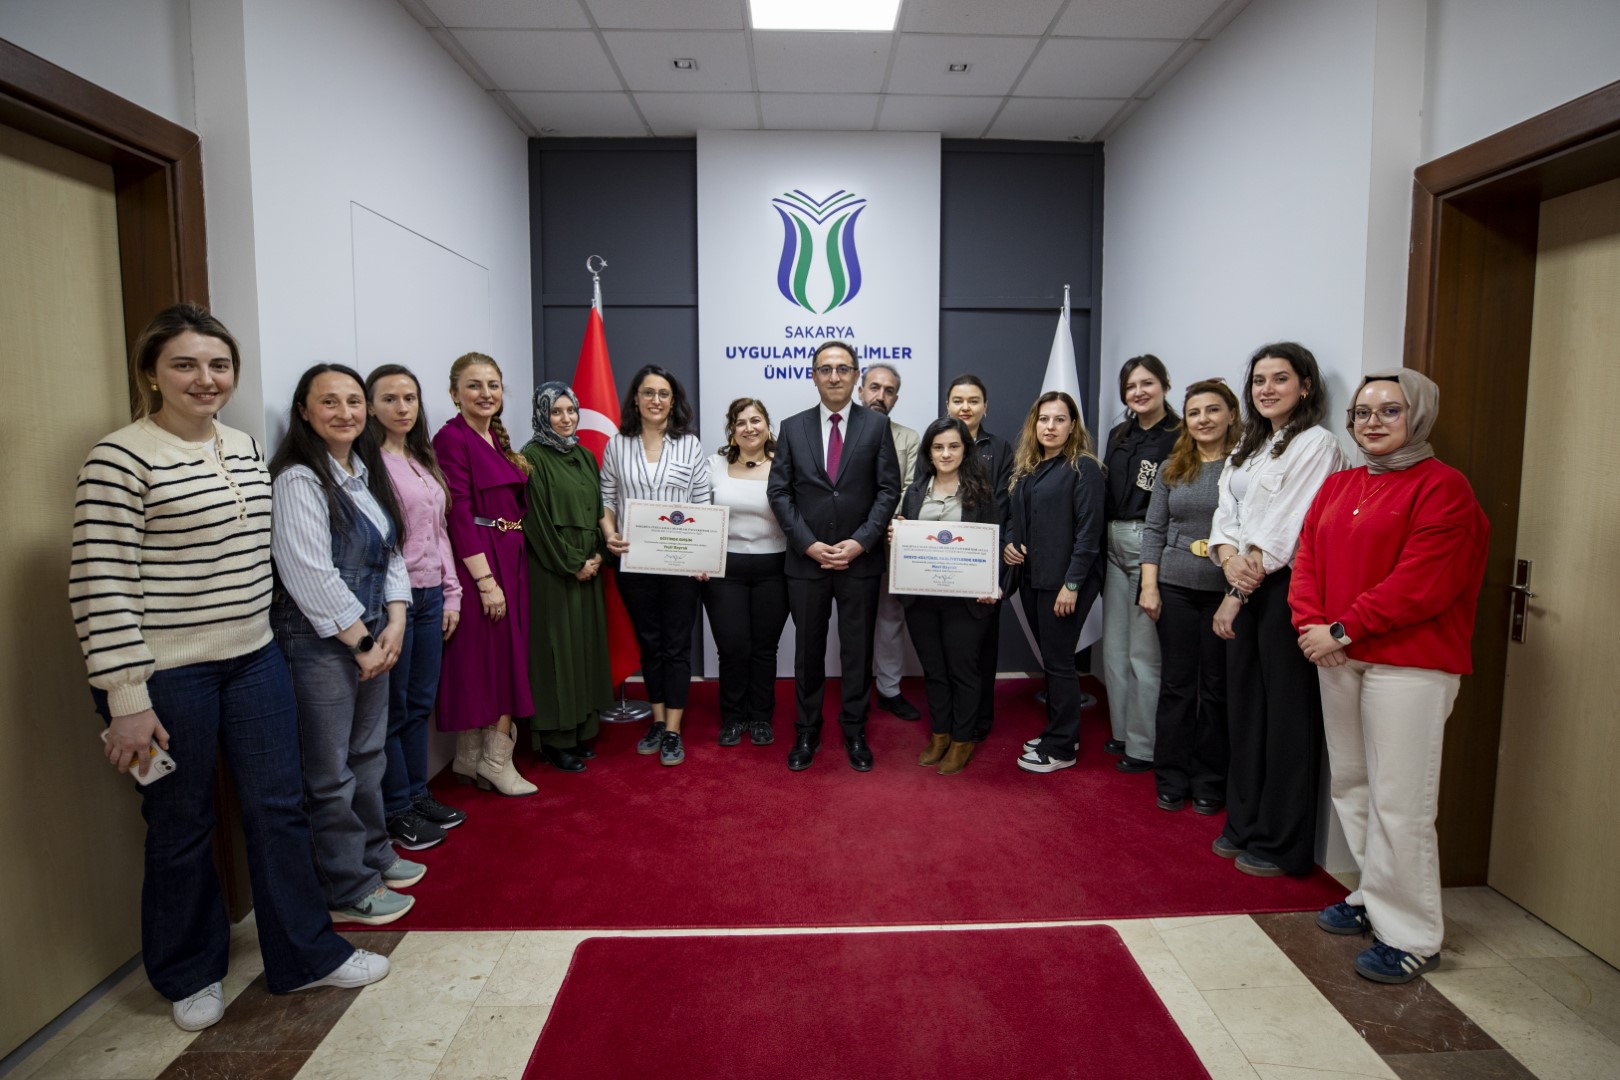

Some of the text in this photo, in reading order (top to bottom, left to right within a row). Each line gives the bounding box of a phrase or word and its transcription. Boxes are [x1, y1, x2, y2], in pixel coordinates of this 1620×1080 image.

[785, 326, 855, 339] SAKARYA
[726, 345, 912, 360] UYGULAMA LİMLER
